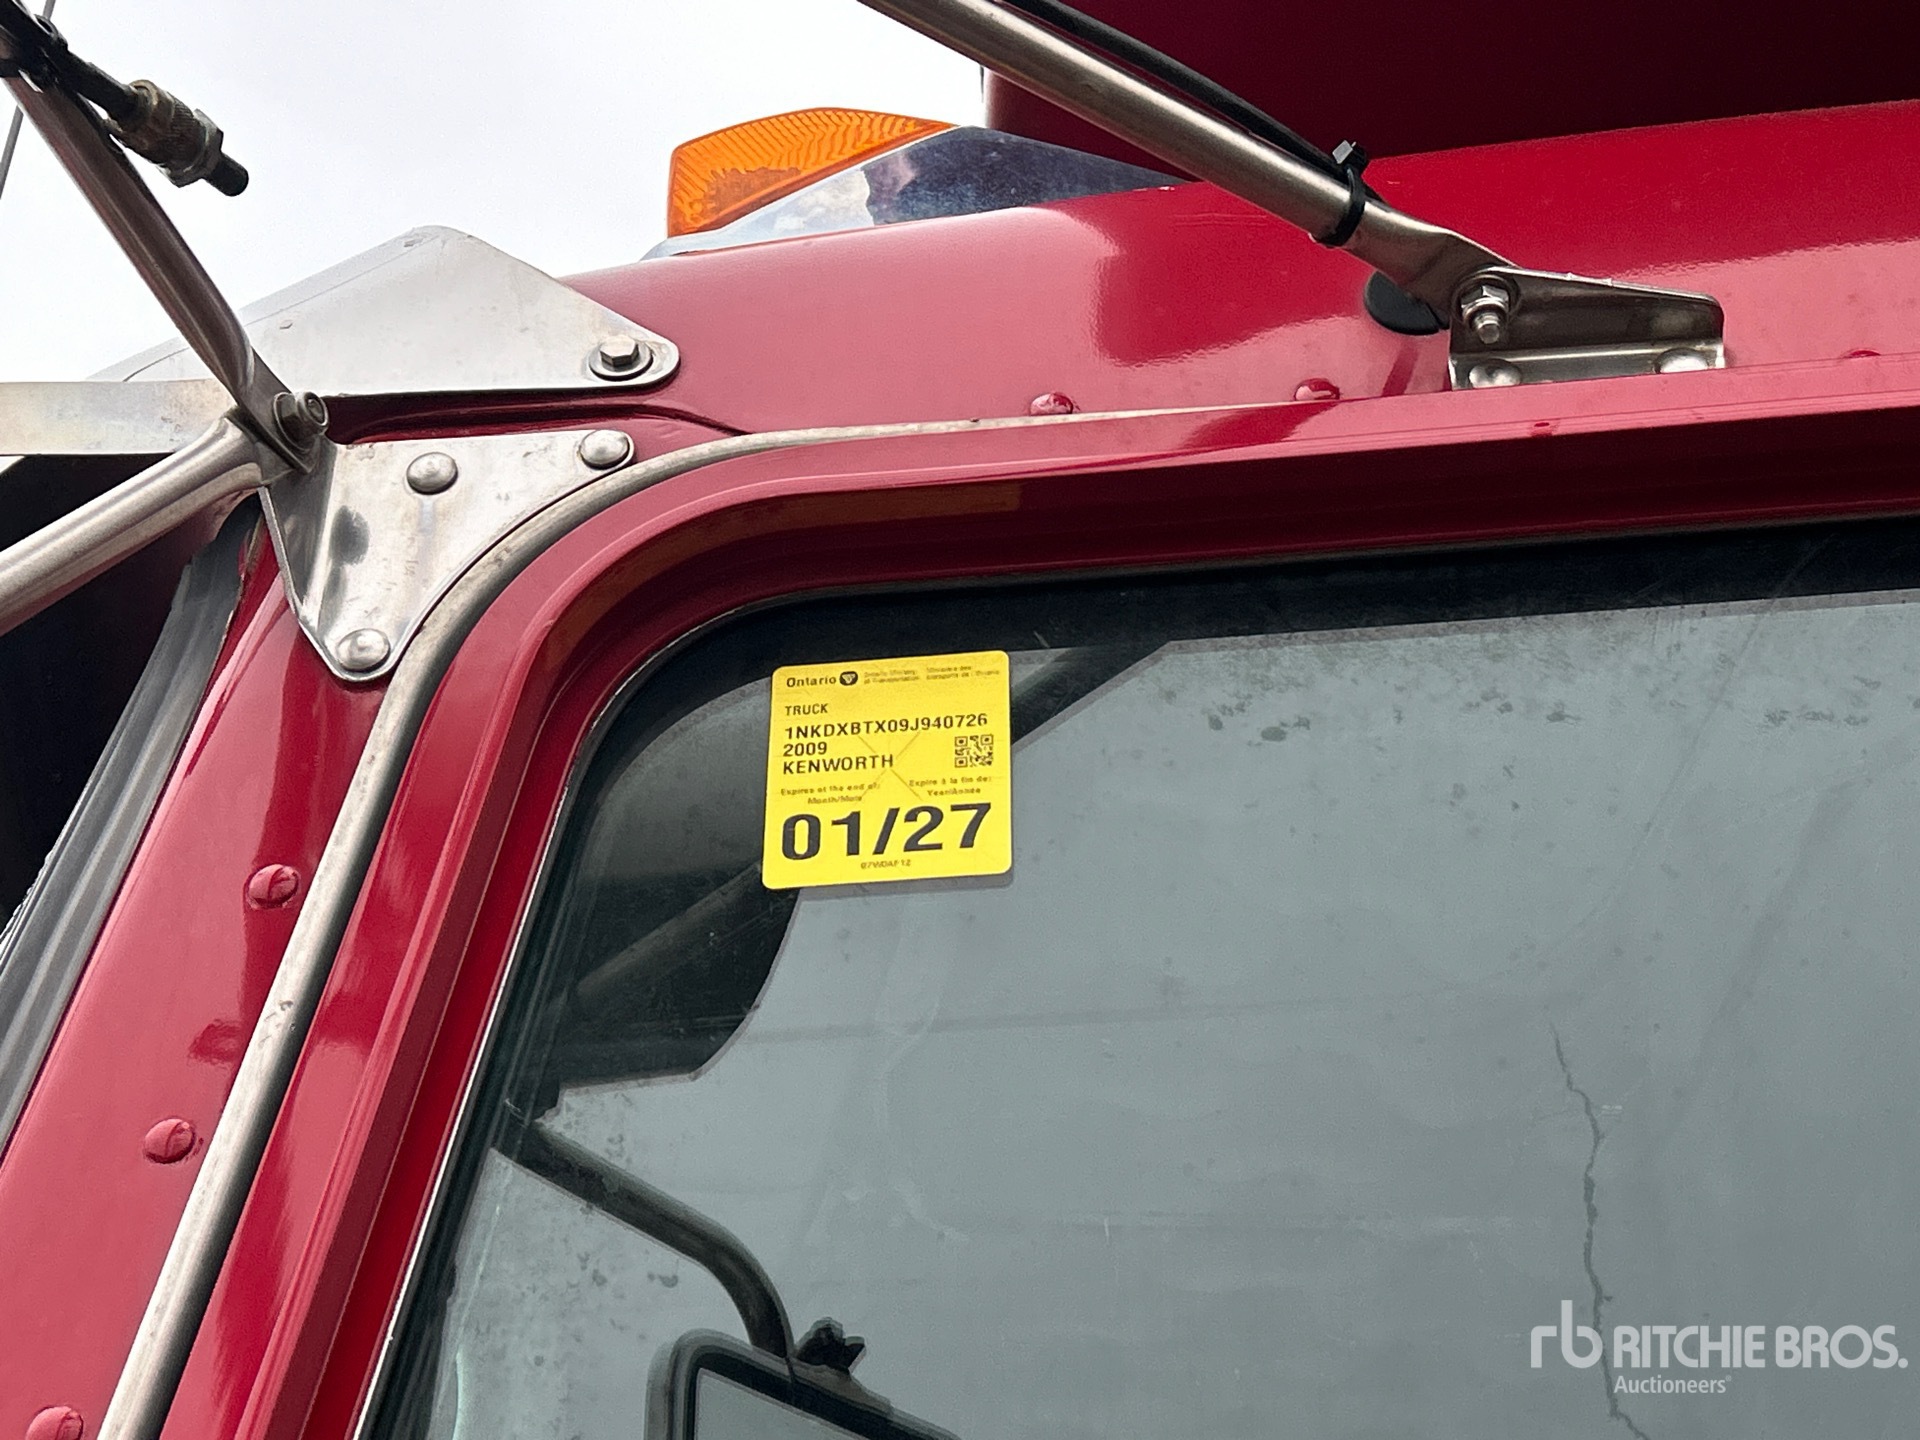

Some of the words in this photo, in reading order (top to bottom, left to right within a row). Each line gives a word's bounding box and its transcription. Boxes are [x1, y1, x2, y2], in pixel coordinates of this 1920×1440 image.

[786, 675, 837, 688] Ontario
[785, 703, 829, 716] TRUCK
[785, 713, 988, 740] 1NKDXBTX09J940726
[783, 742, 828, 757] 2009
[783, 754, 894, 775] KENWORTH
[781, 802, 992, 861] 01/27
